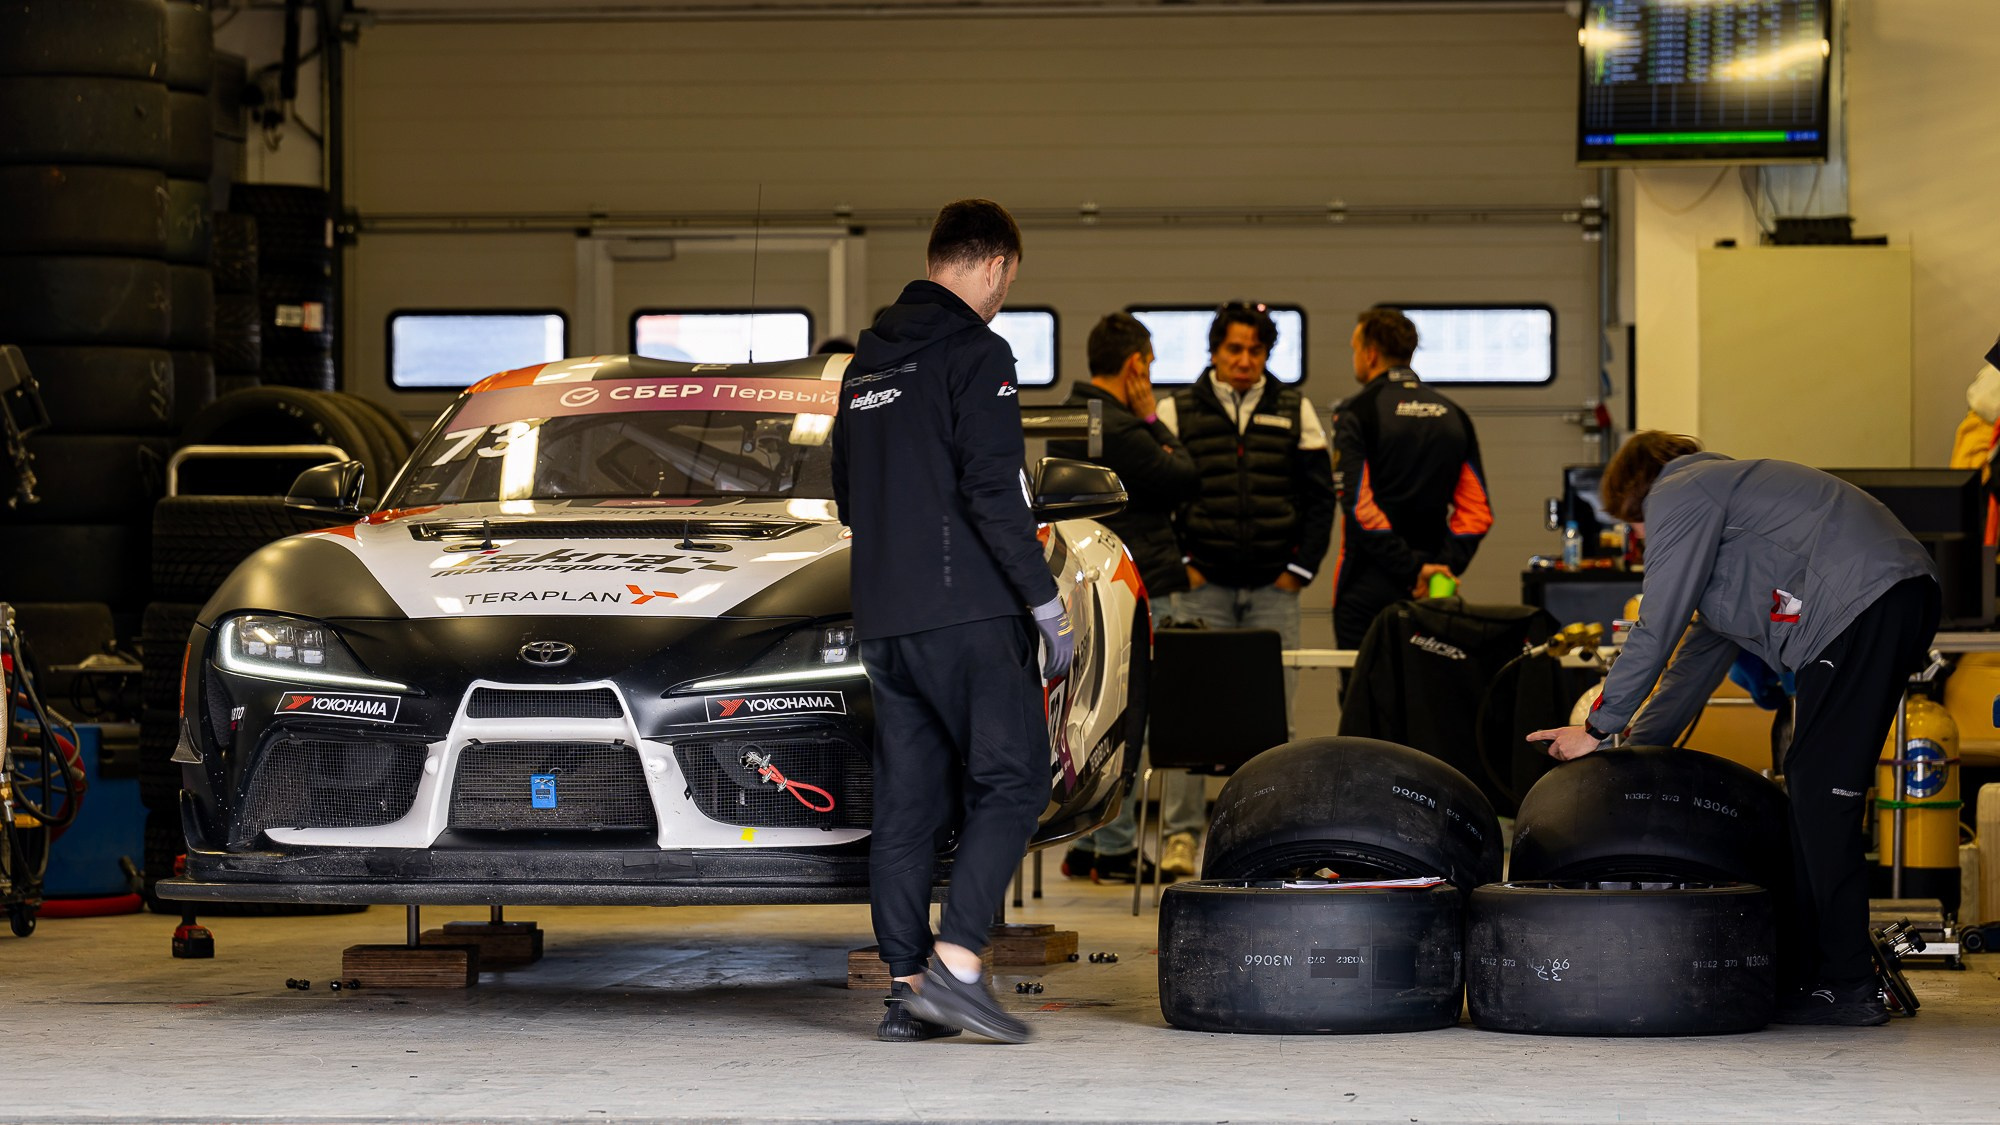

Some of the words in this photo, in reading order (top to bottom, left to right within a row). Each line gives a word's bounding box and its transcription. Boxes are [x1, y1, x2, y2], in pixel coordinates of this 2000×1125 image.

[609, 384, 704, 399] СБЕР
[712, 384, 838, 405] Первый
[850, 388, 897, 409] iskra
[431, 421, 531, 467] 73
[449, 549, 687, 567] iskra
[430, 563, 658, 578] motorsport
[465, 591, 622, 605] TERAPLAN
[312, 698, 387, 716] YOKOHAMA
[745, 696, 835, 712] YOKOHAMA
[1392, 785, 1436, 809] N3066
[1662, 794, 1680, 802] 373
[1692, 796, 1738, 818] N3066
[1244, 954, 1293, 967] N3066
[1307, 956, 1326, 964] 373
[1502, 958, 1516, 967] 373
[1724, 959, 1738, 968] 373
[1746, 955, 1769, 968] N3066
